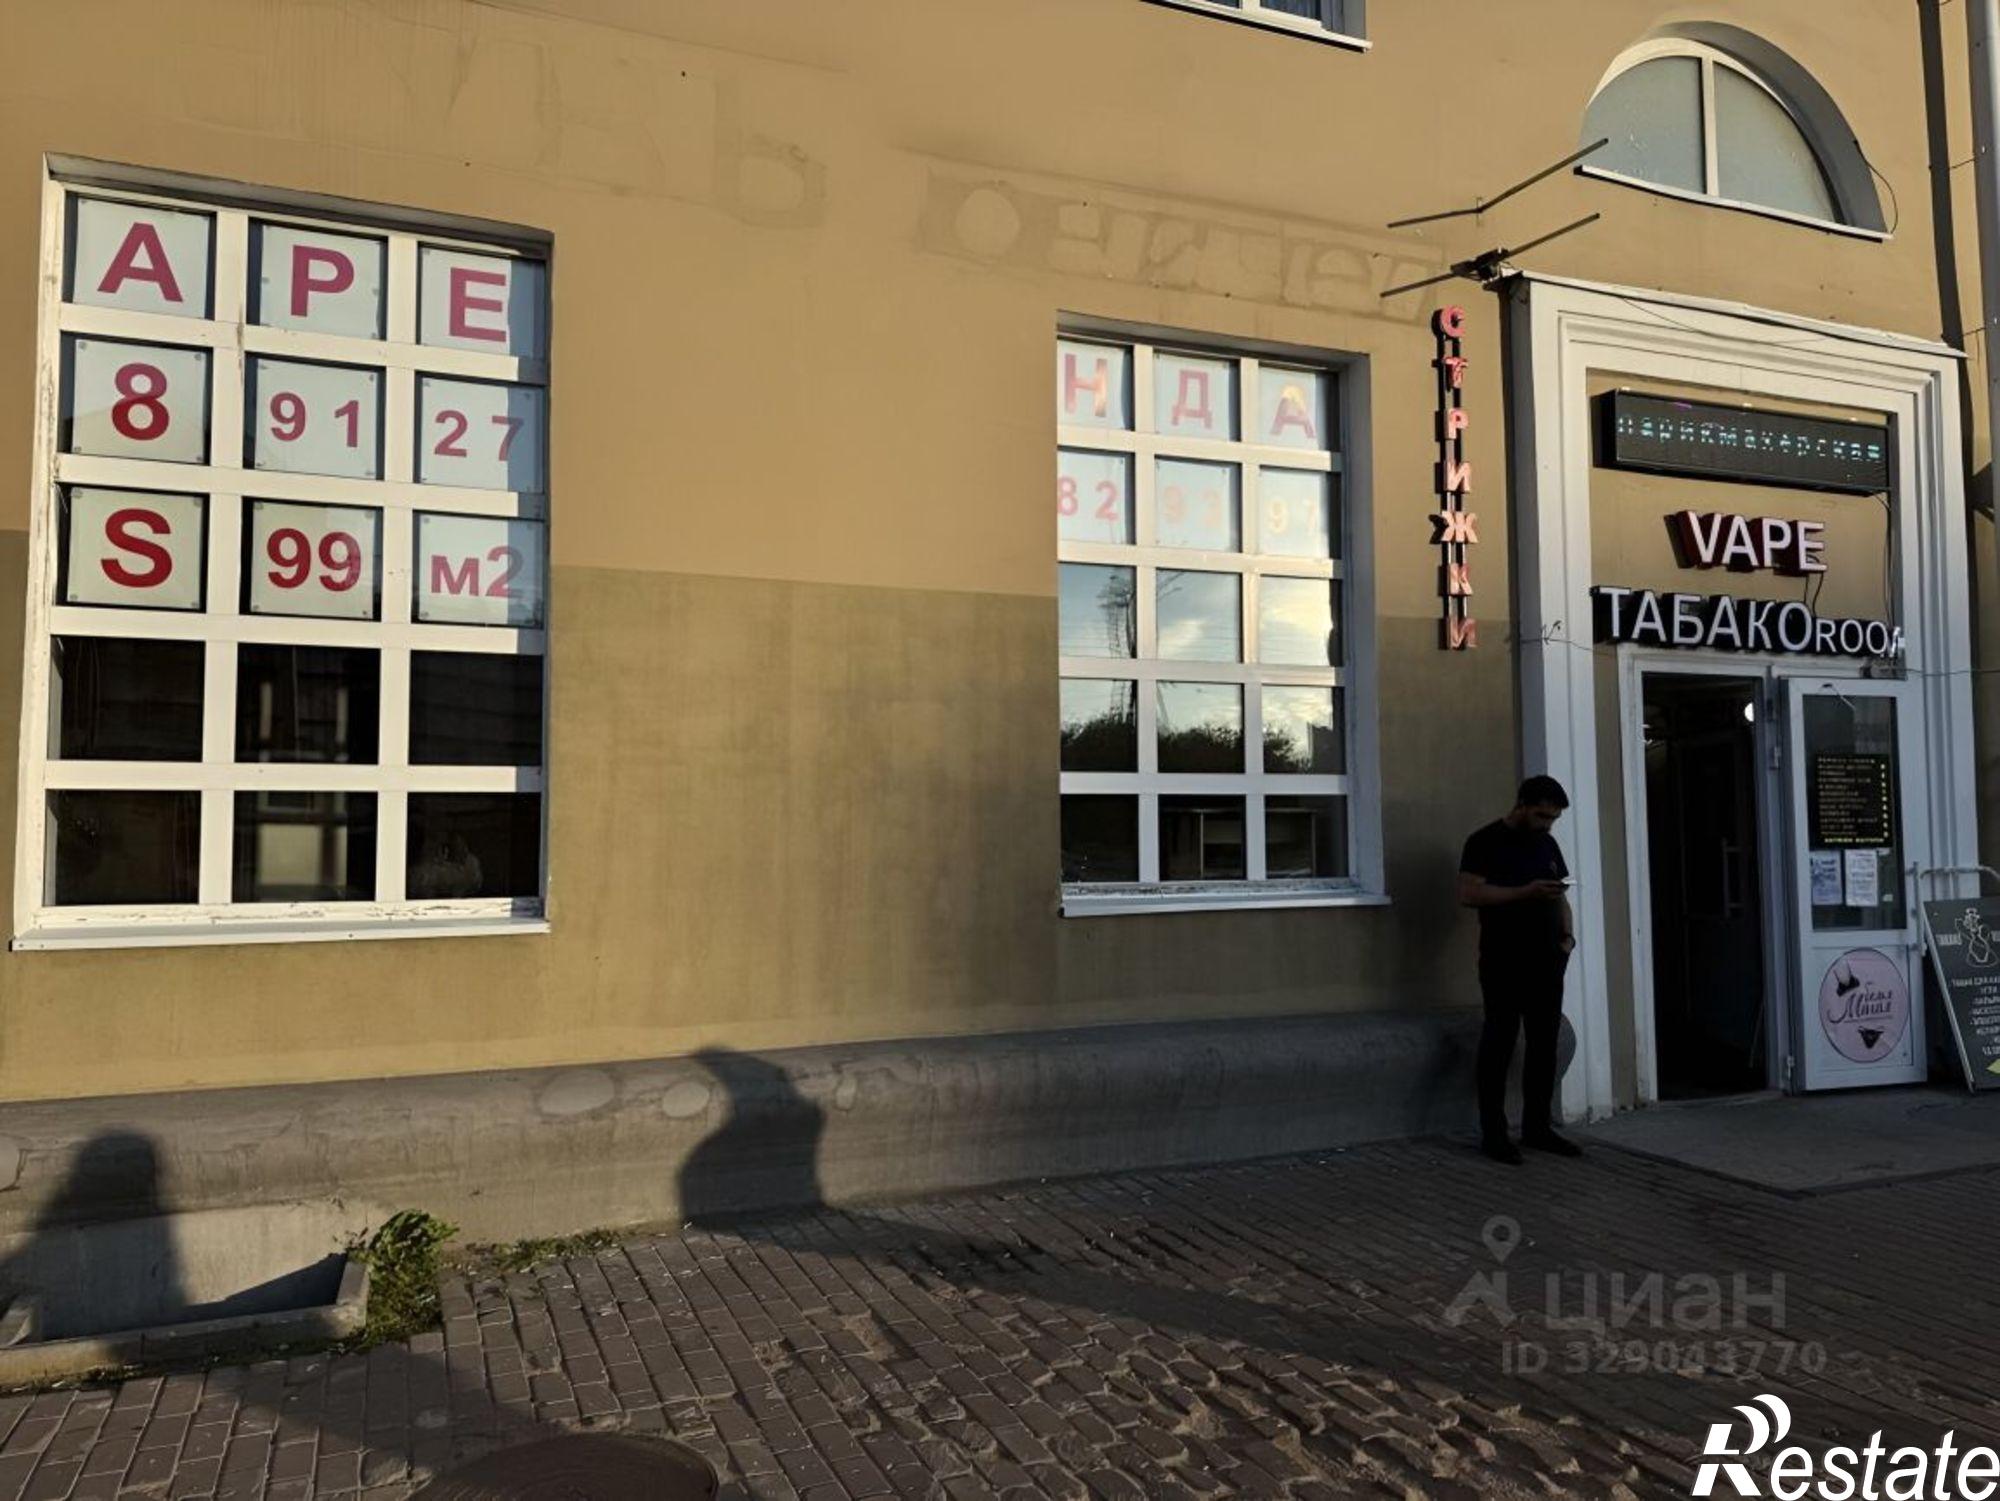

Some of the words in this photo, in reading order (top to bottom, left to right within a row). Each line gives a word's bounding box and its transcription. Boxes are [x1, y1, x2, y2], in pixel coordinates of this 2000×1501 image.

[1437, 305, 1479, 649] СТРИЖКИ
[100, 509, 173, 588] S
[266, 528, 361, 592] 99
[1684, 510, 1828, 572] VAPE
